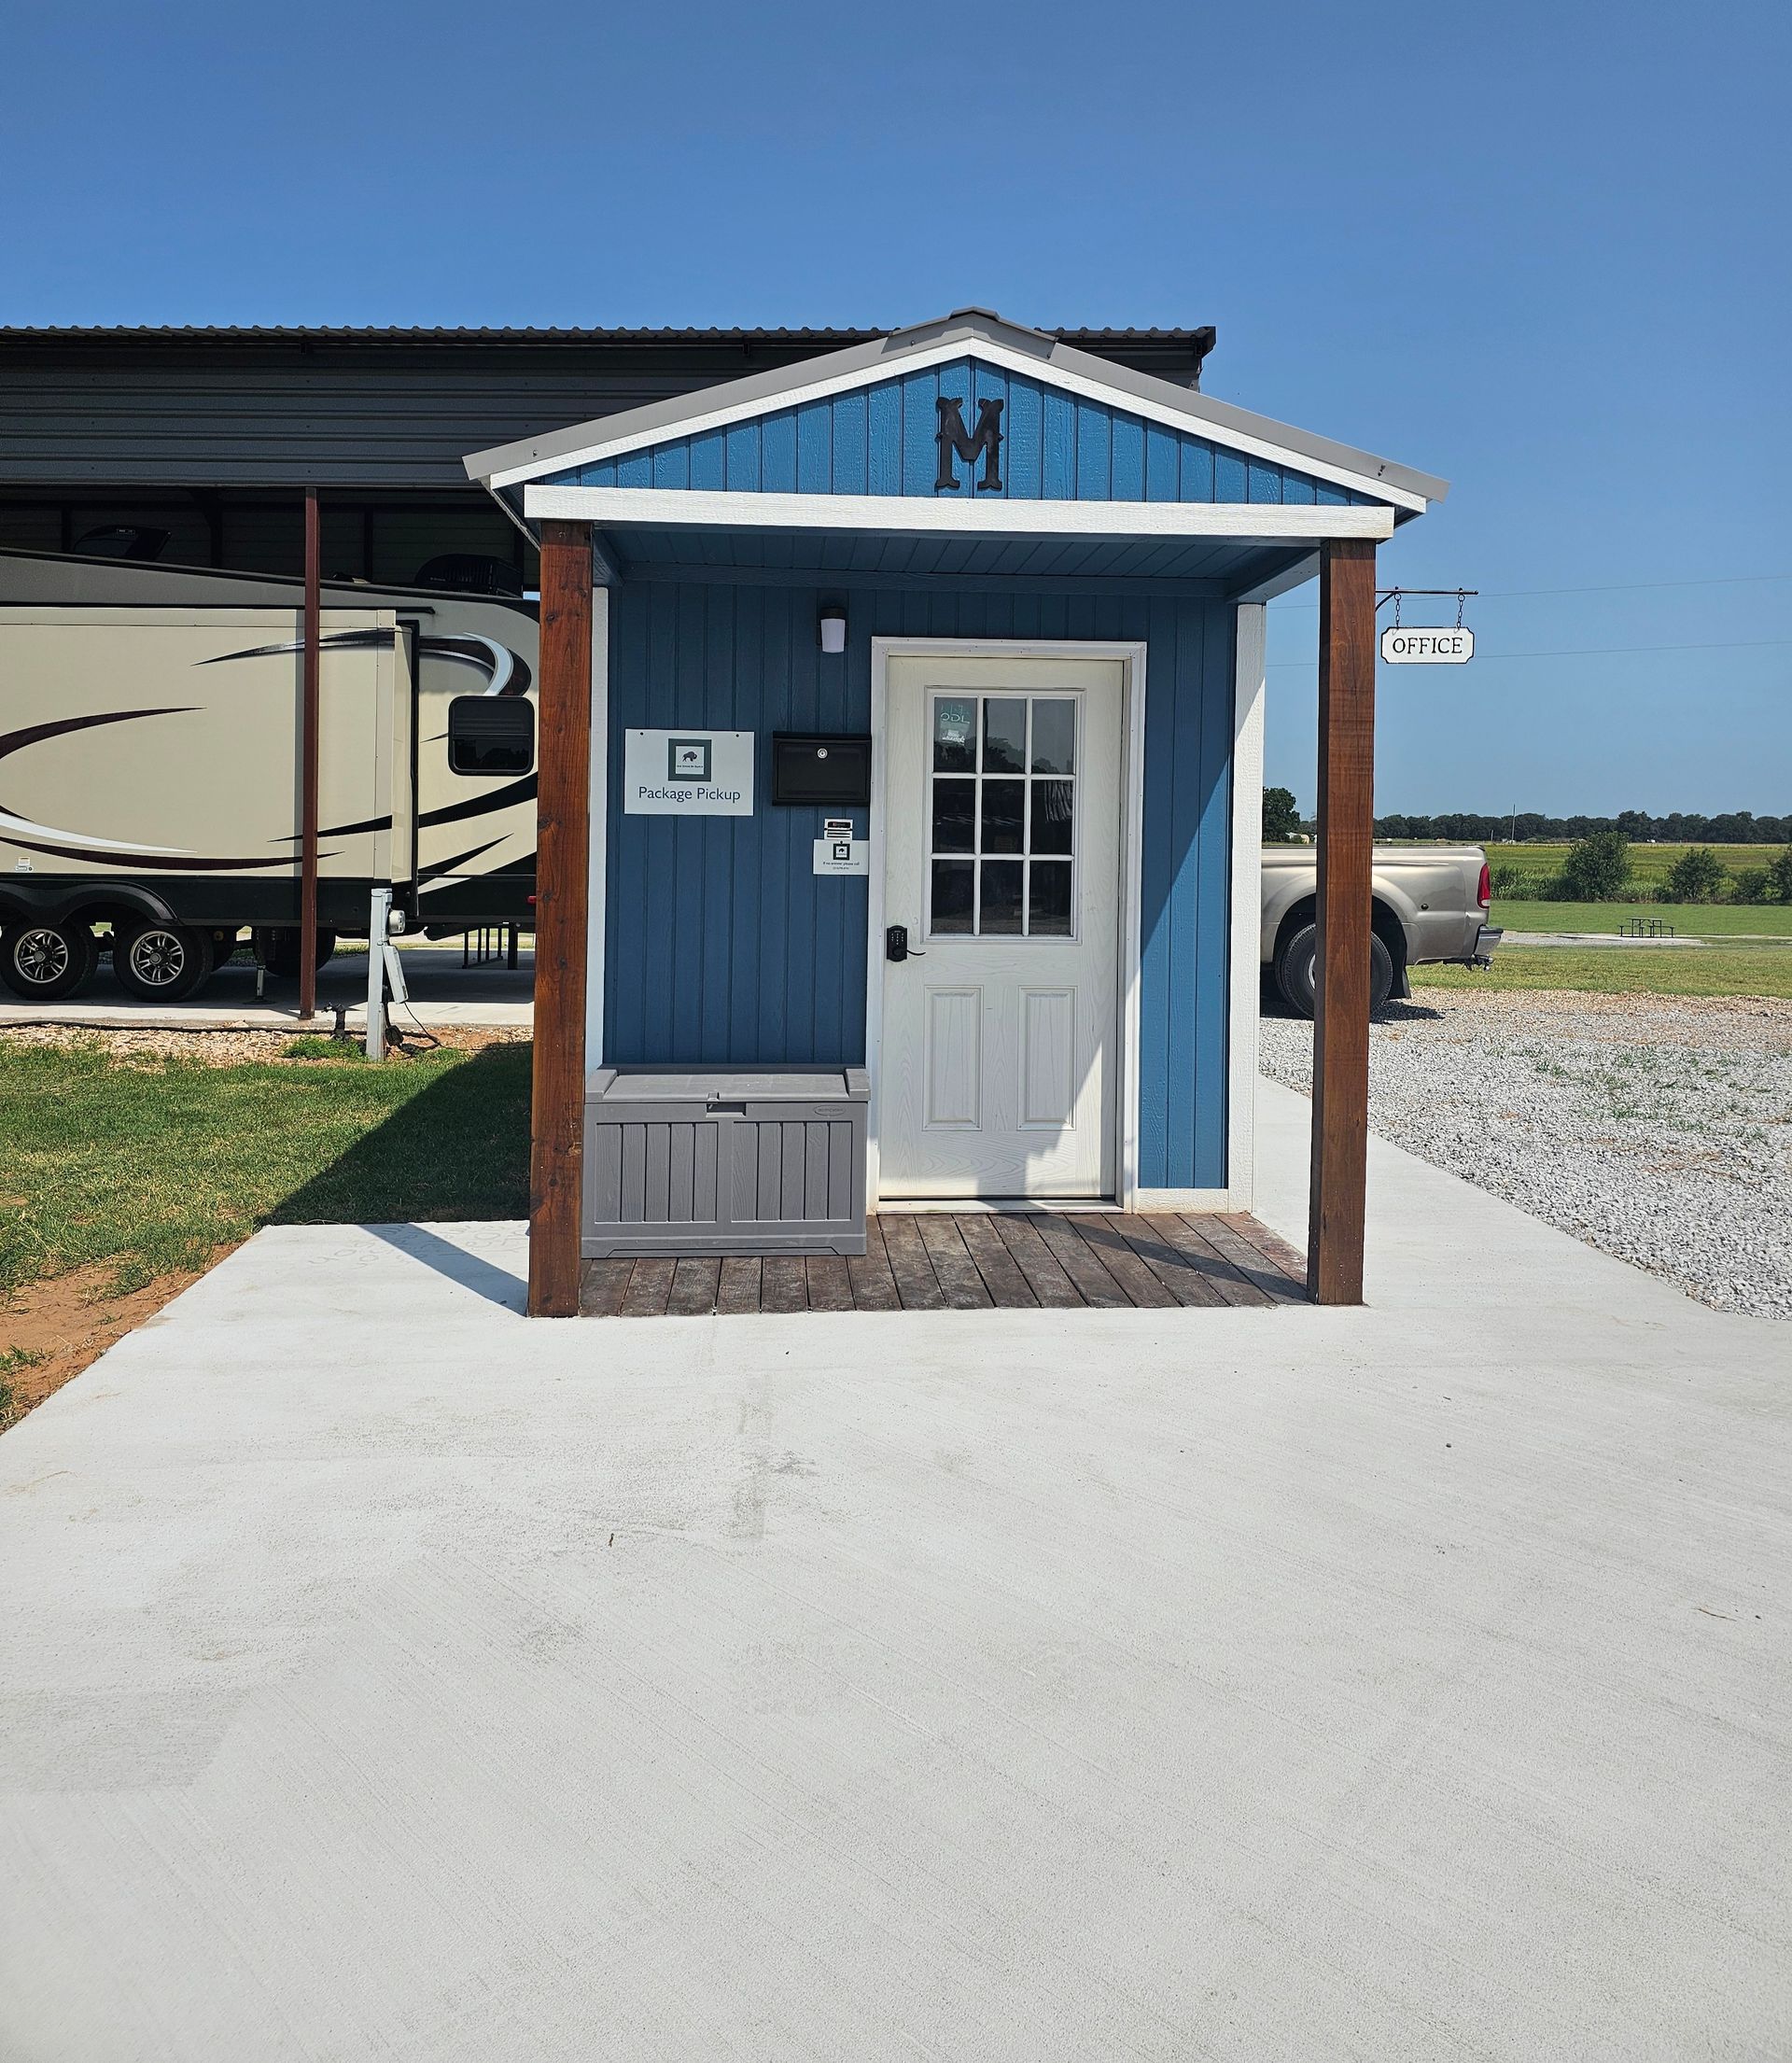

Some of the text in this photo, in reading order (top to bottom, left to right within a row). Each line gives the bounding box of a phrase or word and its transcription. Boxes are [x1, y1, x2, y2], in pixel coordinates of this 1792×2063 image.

[934, 397, 1004, 491] M
[1393, 637, 1463, 653] OFFICE
[638, 786, 740, 804] Package Pickup
